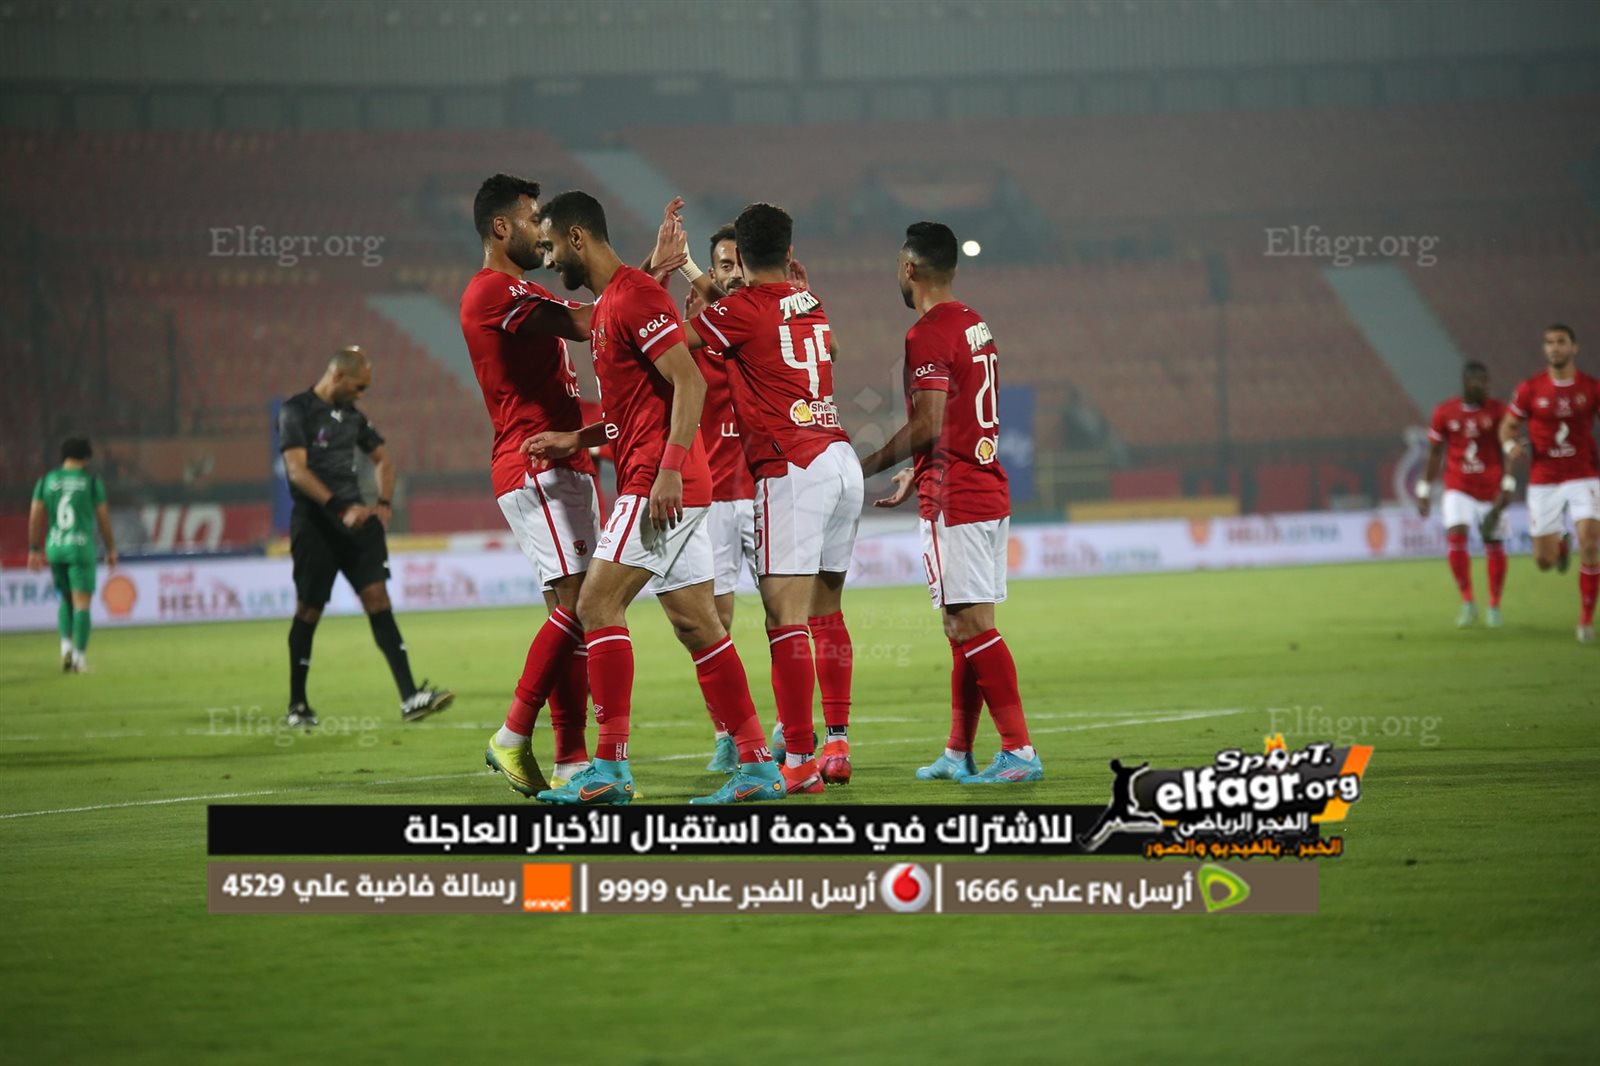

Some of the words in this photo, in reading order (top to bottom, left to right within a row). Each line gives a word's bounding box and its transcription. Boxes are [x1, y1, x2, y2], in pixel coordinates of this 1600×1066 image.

[646, 314, 669, 332] GLC
[915, 363, 936, 377] GLC
[56, 491, 76, 531] 6
